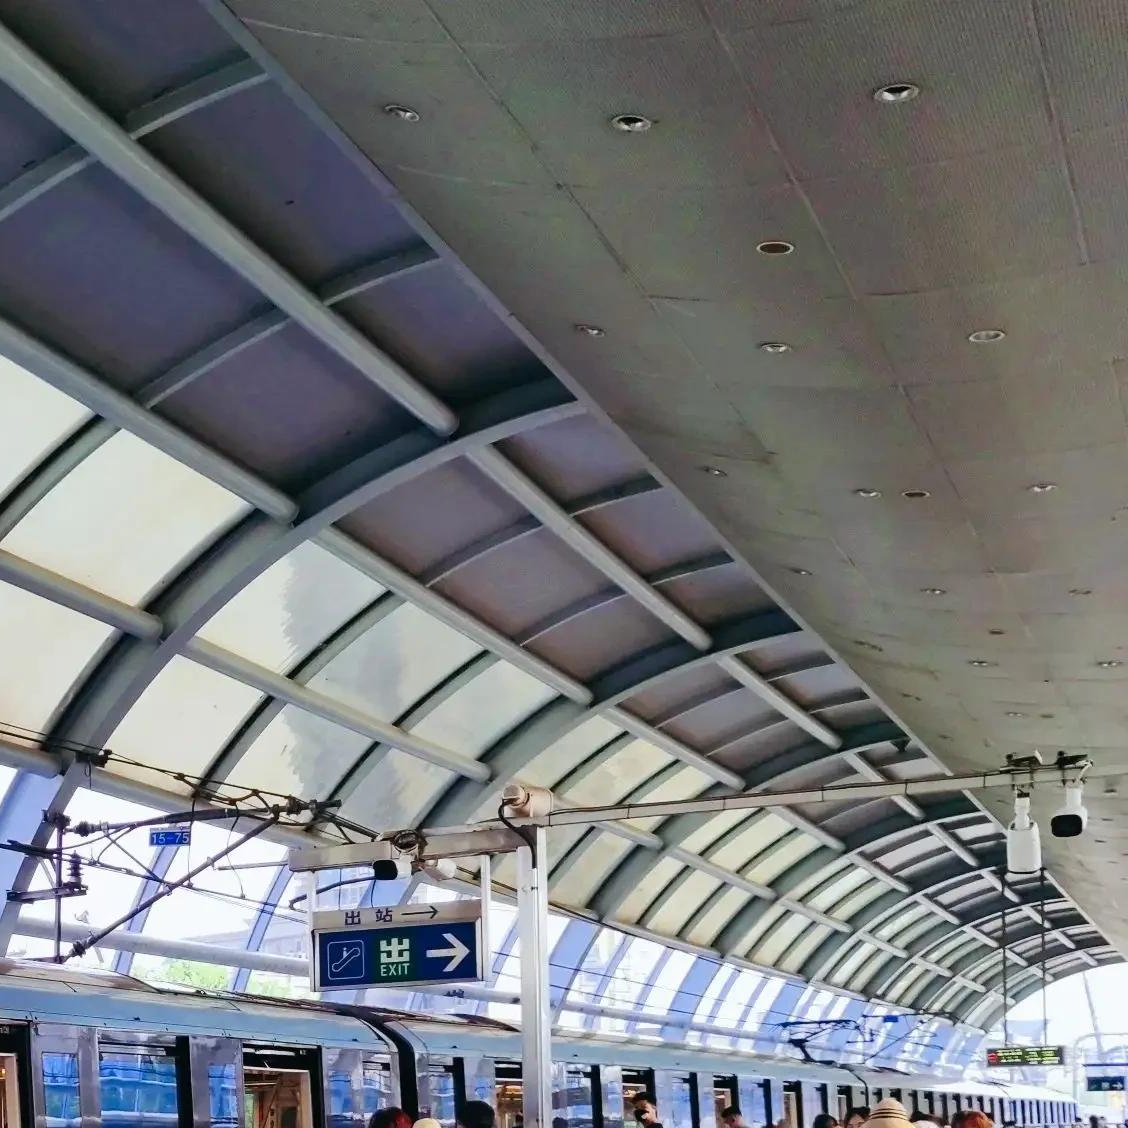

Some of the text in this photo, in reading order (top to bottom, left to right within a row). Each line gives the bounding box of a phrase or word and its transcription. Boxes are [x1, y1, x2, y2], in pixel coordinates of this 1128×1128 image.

[152, 832, 190, 844] 15-75
[344, 907, 393, 926] 出站
[379, 937, 410, 963] 出
[380, 963, 410, 977] EXIT
